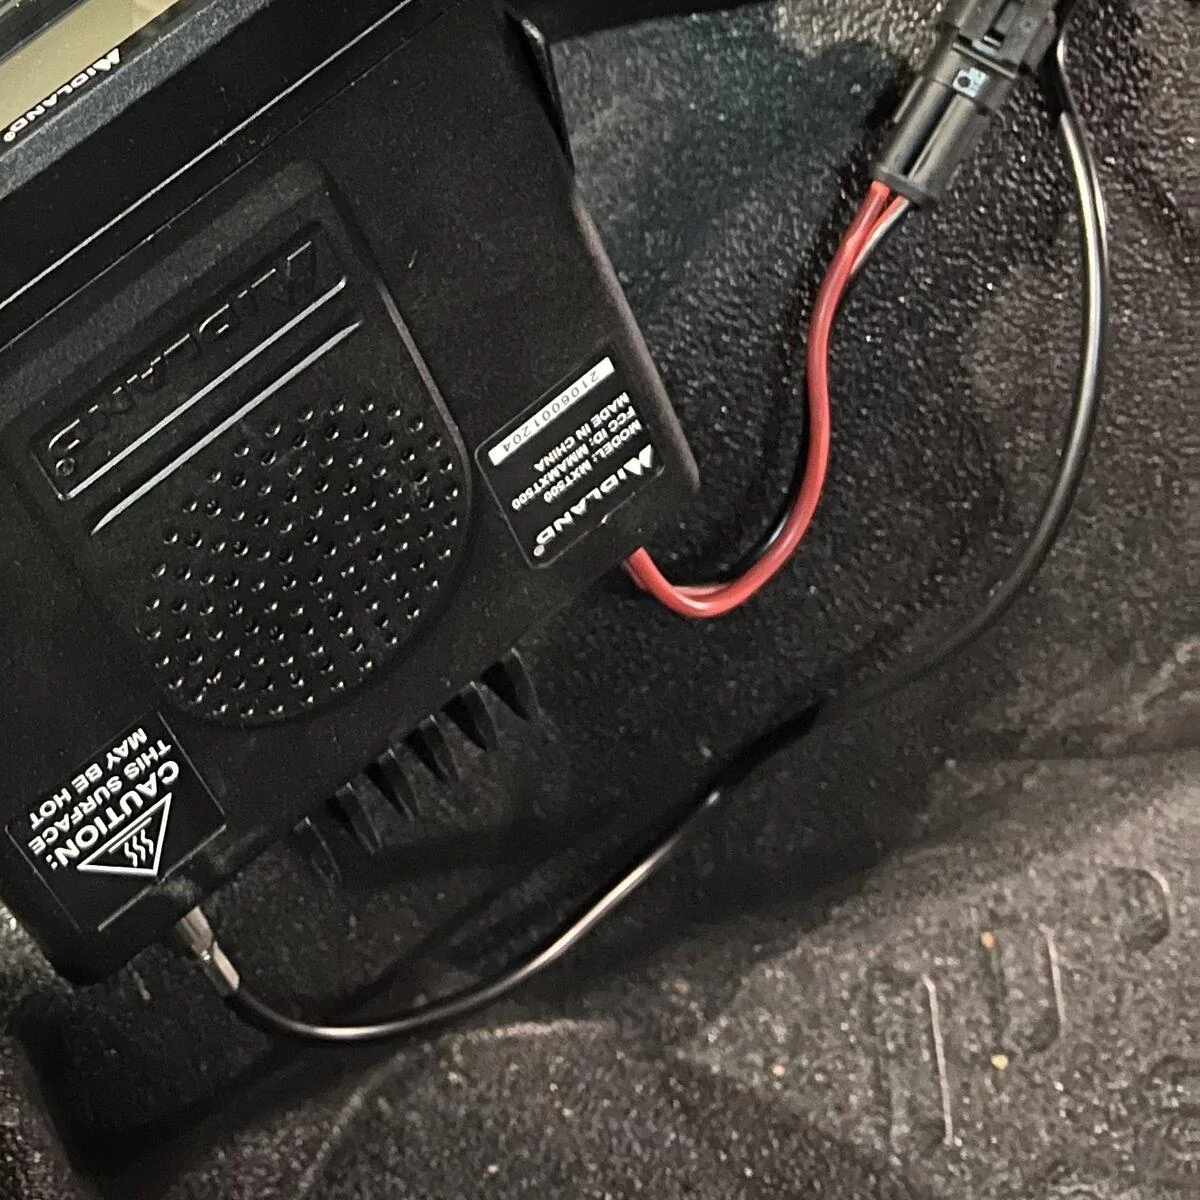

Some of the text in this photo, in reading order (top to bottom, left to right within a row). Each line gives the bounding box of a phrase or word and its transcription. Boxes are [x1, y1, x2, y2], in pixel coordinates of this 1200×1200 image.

[502, 370, 599, 454] 2106001204
[533, 392, 630, 473] MADE IN CHINA
[588, 428, 609, 447] ID:
[607, 405, 637, 433] FCC
[543, 419, 643, 503] MODEL: MXT500
[28, 739, 172, 855] THIS SURFACE
[29, 727, 148, 830] MAY BE HOT
[45, 760, 179, 870] CAUTION:
